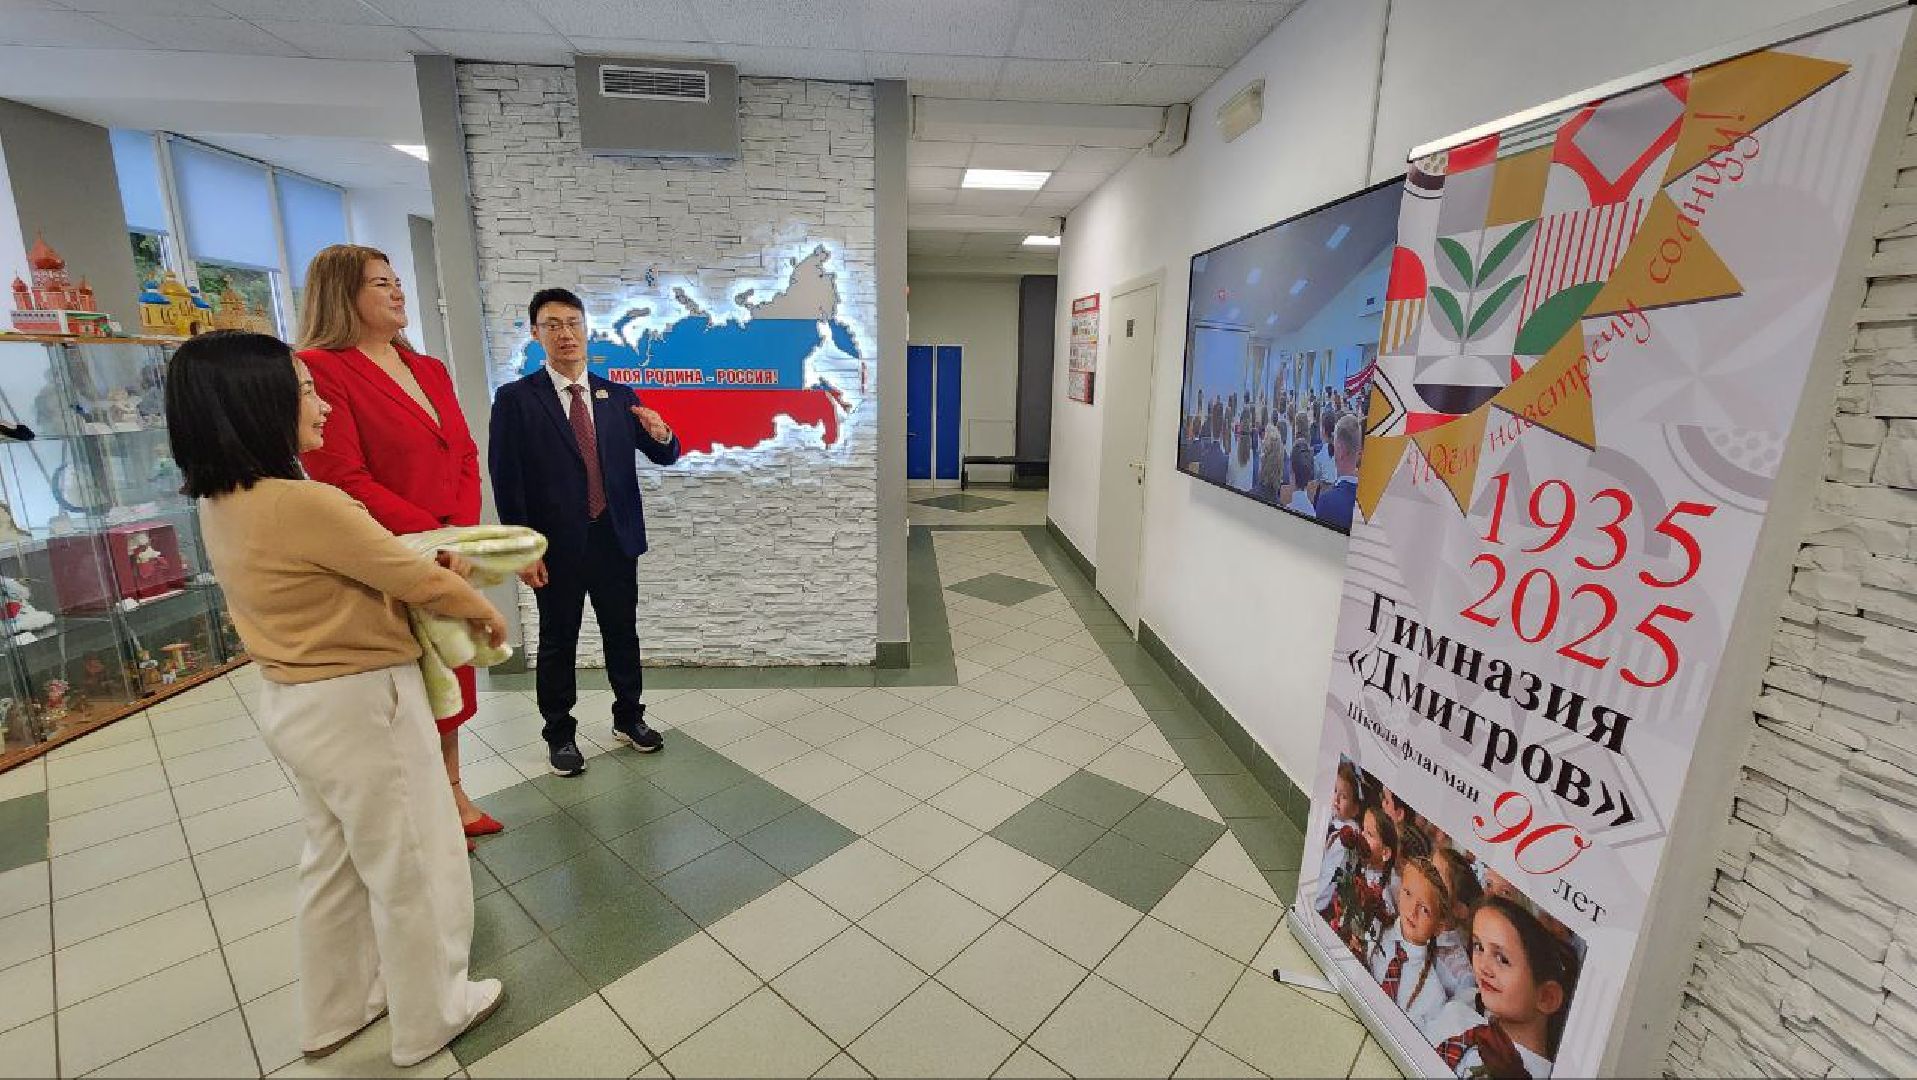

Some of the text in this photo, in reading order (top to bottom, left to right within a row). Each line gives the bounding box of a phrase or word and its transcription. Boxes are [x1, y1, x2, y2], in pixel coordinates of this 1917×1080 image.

[1489, 298, 1651, 452] навстречу
[1649, 112, 1760, 284] солнцу!
[609, 368, 642, 384] МОЯ
[645, 368, 704, 387] РОДИНА
[716, 369, 778, 385] РОССИЯ!
[1480, 472, 1718, 588] 1935
[1366, 591, 1633, 754] Гимназия
[1460, 553, 1694, 688] 2025
[1347, 646, 1637, 828] «Дмитров»
[1401, 738, 1480, 803] флагман
[1472, 790, 1607, 922] 90 лет
